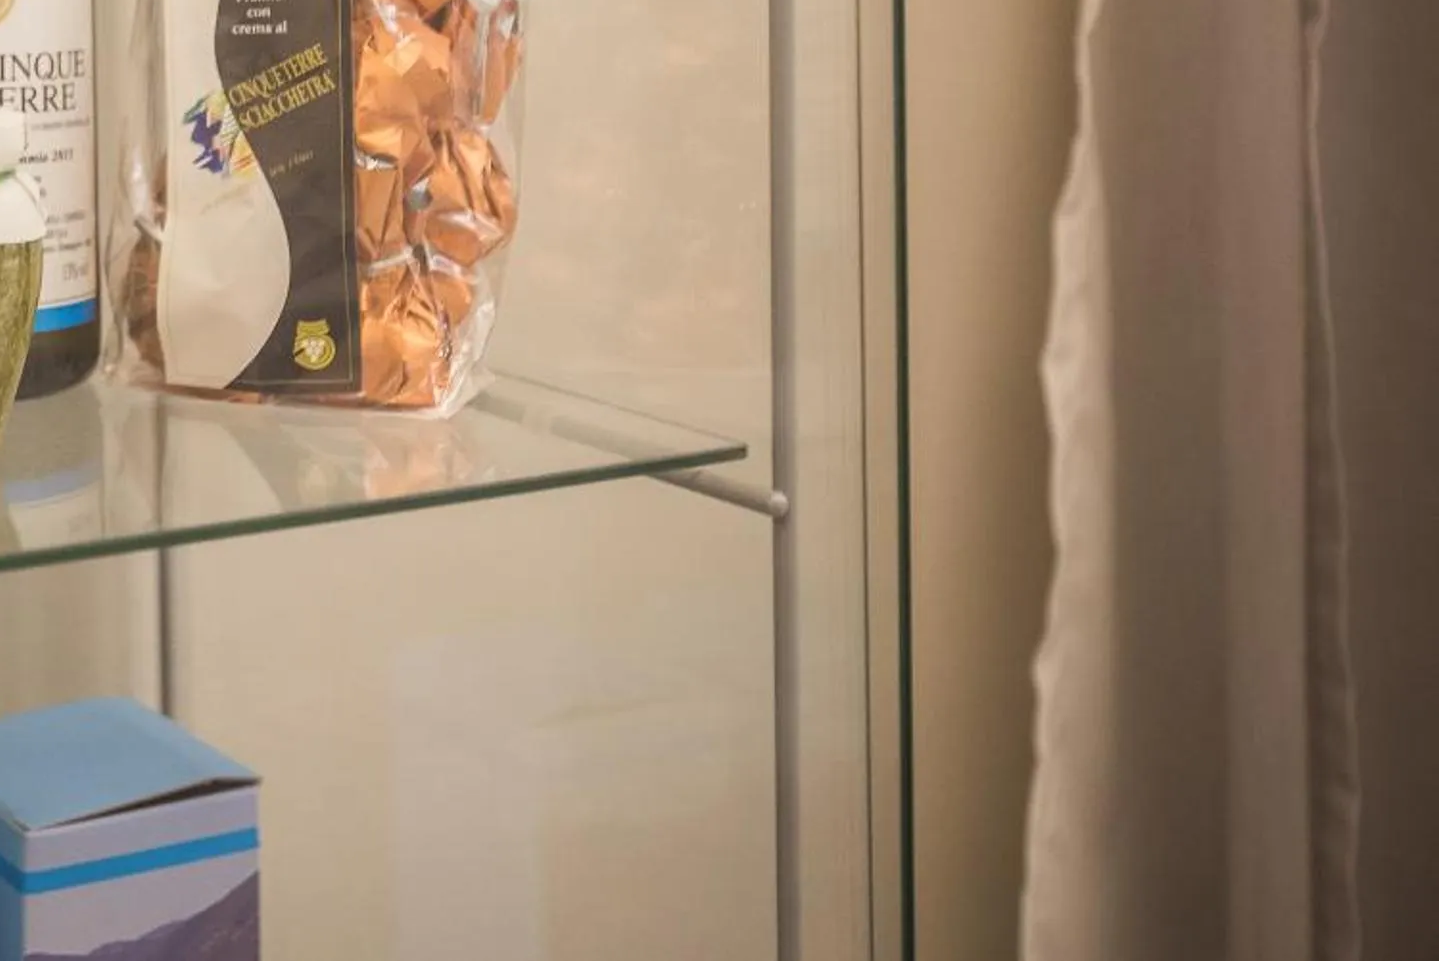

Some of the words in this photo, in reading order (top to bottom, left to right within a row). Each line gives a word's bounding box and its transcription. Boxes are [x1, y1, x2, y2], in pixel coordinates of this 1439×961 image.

[246, 7, 271, 18] con
[231, 24, 273, 35] crema
[275, 20, 287, 34] al
